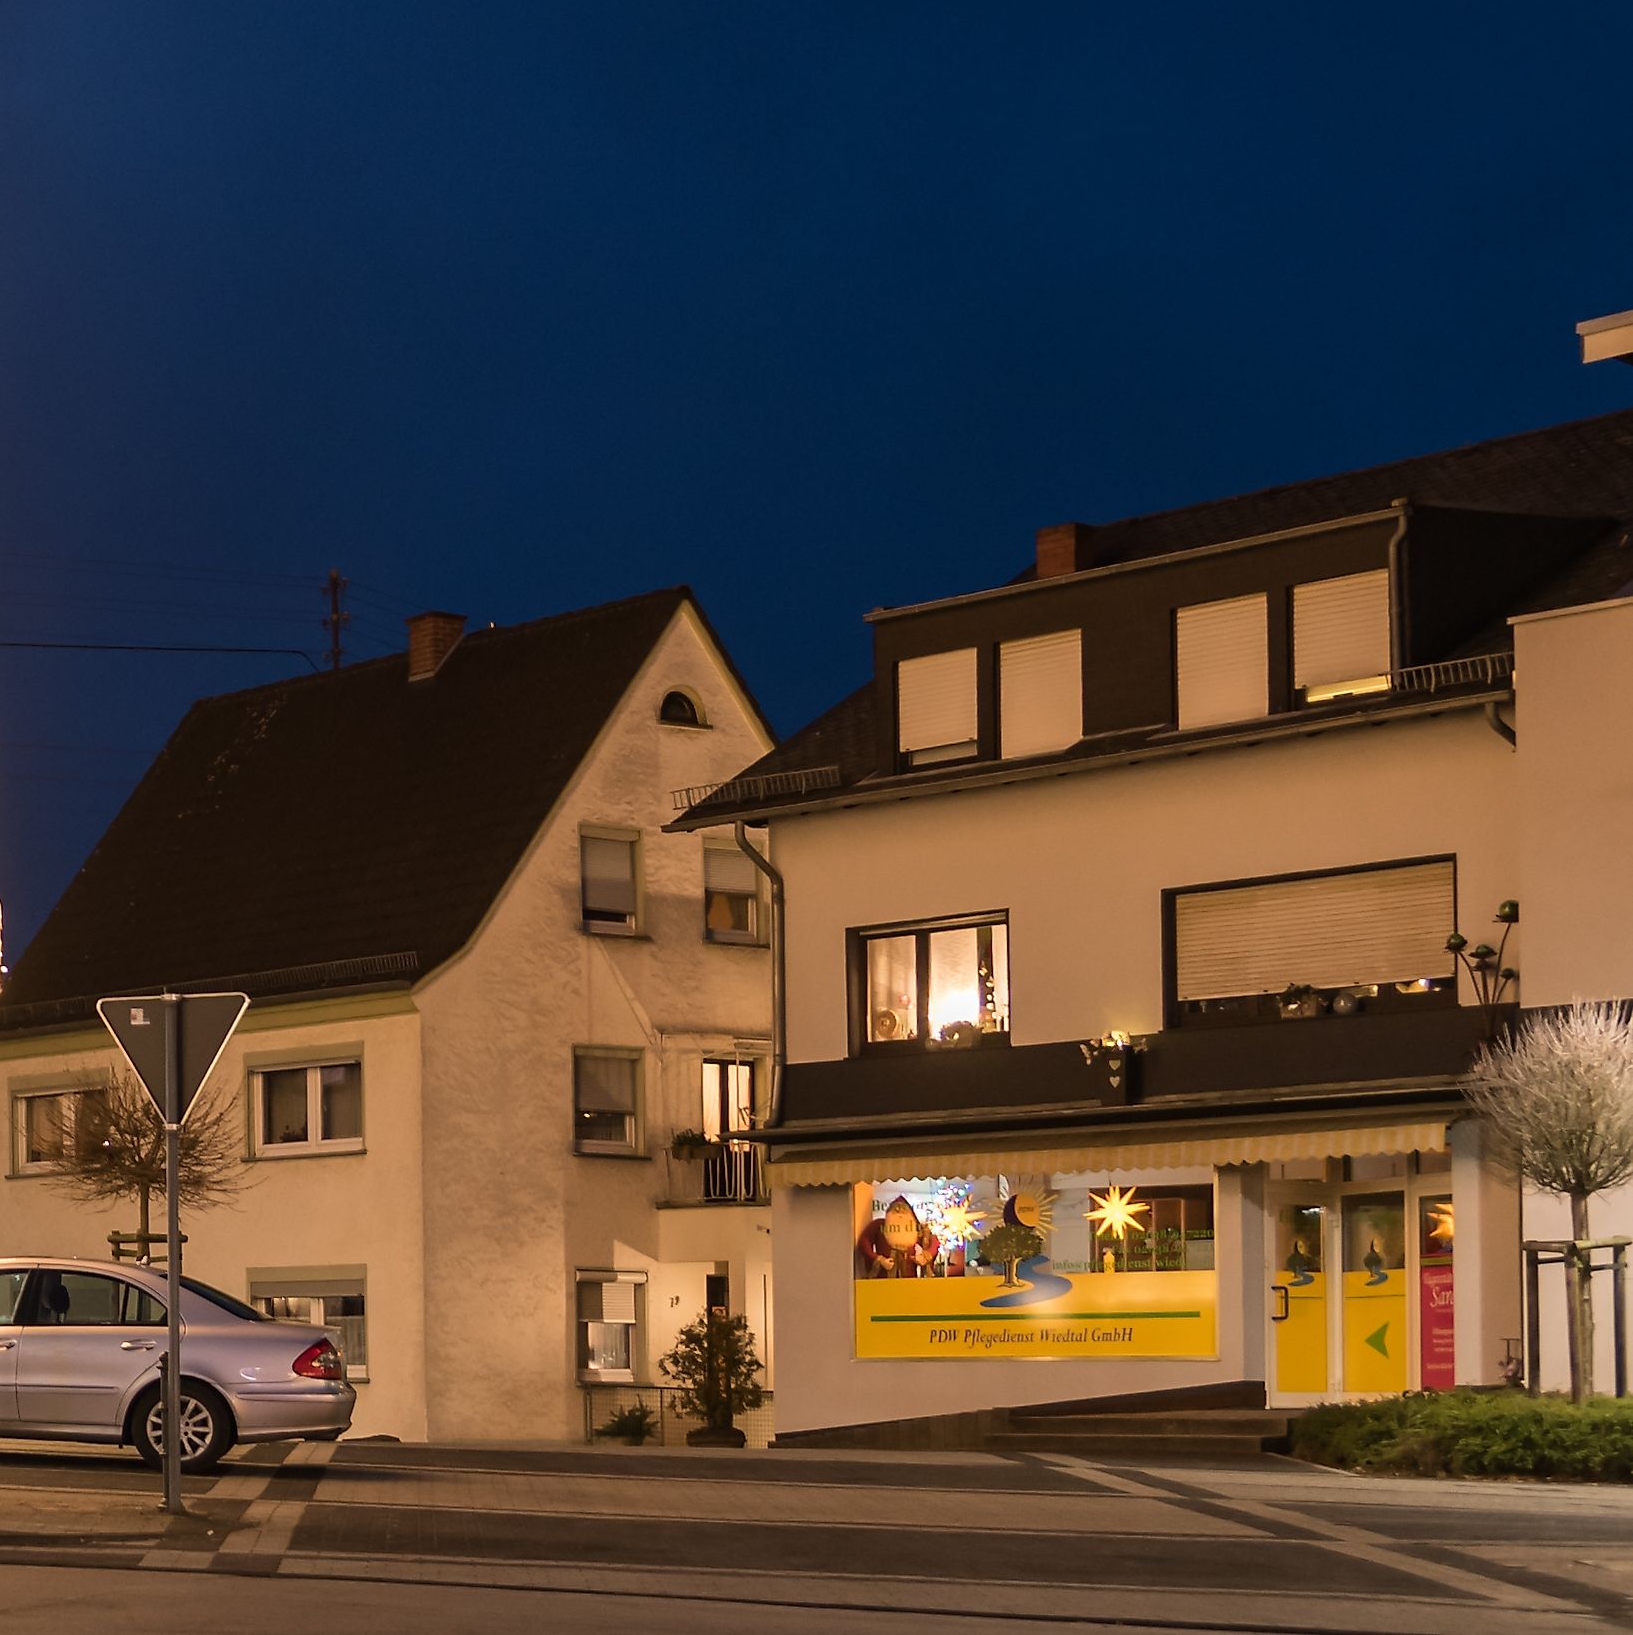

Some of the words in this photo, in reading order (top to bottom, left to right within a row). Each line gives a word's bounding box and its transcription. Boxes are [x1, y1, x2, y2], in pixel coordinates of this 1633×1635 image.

[929, 1328, 960, 1343] PDW
[963, 1328, 1035, 1349] Pflegedienst
[1039, 1328, 1088, 1343] Wiedtal
[1091, 1327, 1133, 1342] GmbH
